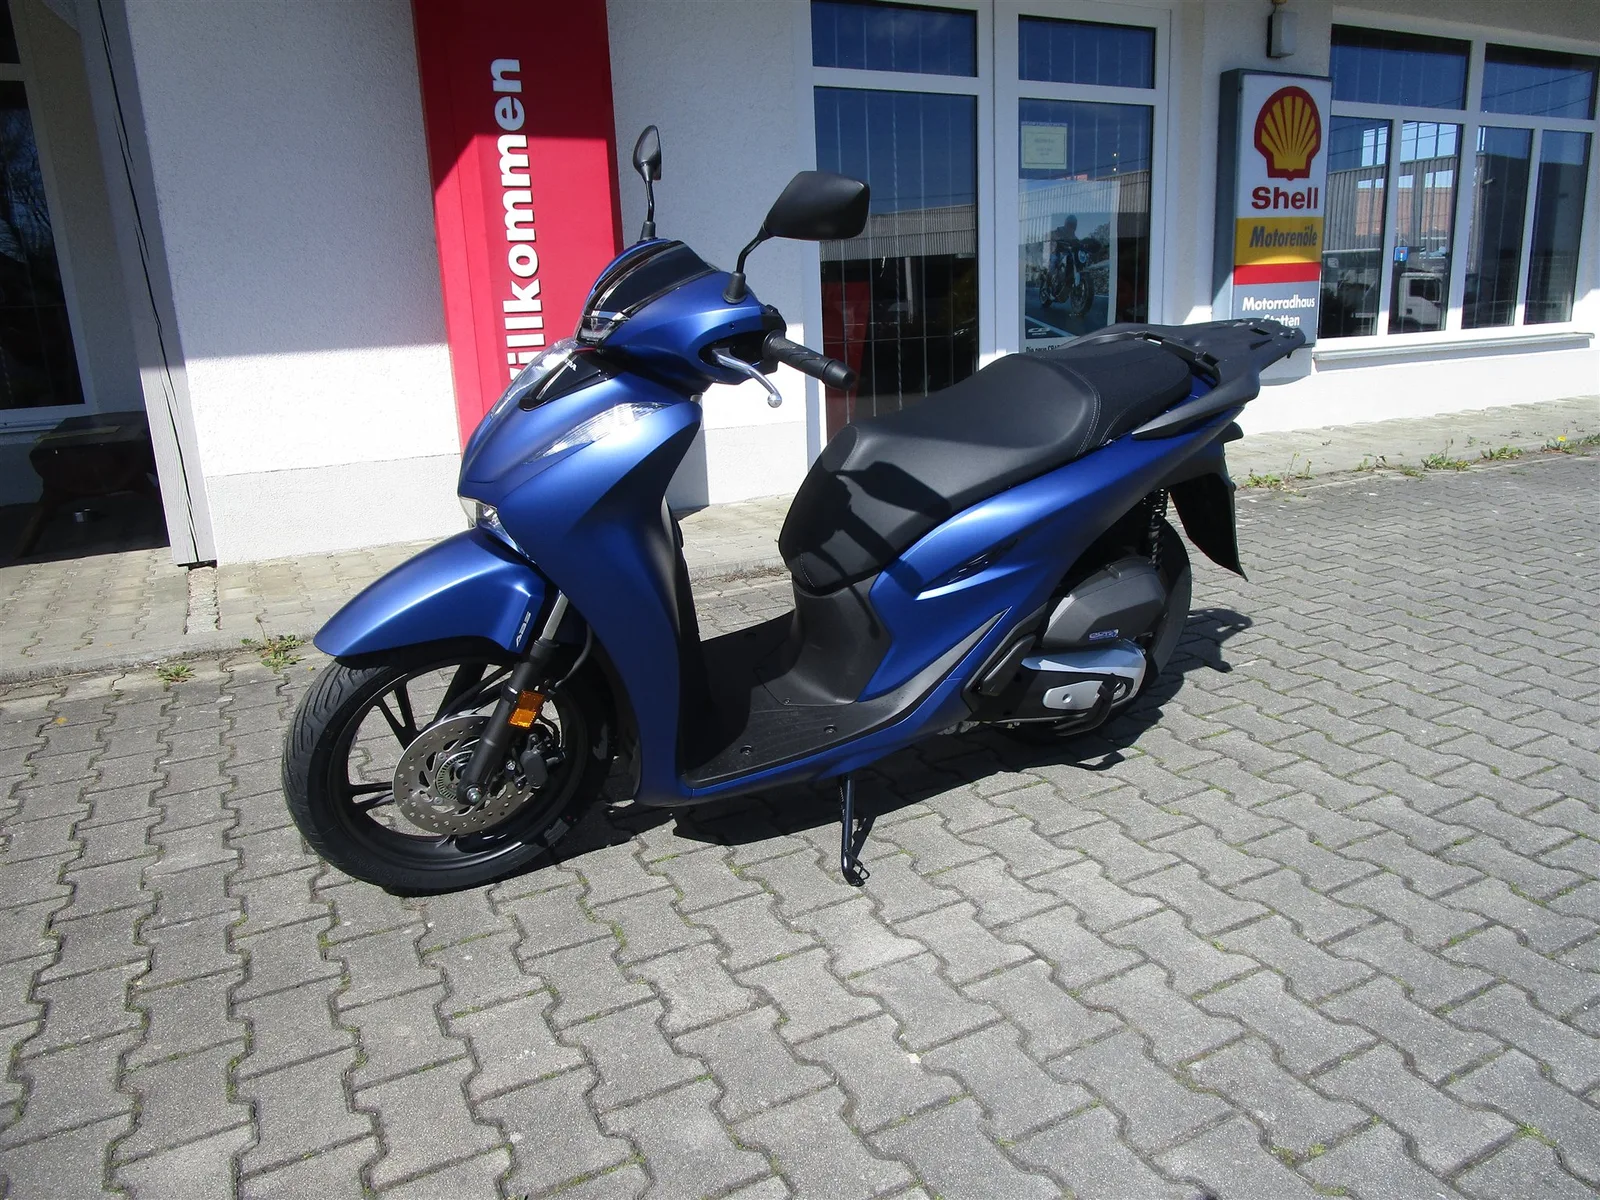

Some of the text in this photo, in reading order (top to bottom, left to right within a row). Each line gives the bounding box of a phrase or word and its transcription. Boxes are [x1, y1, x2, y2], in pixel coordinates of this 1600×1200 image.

[1251, 186, 1319, 210] Shell
[1249, 224, 1318, 248] Motorenöle
[1242, 294, 1315, 311] Motorradhaus
